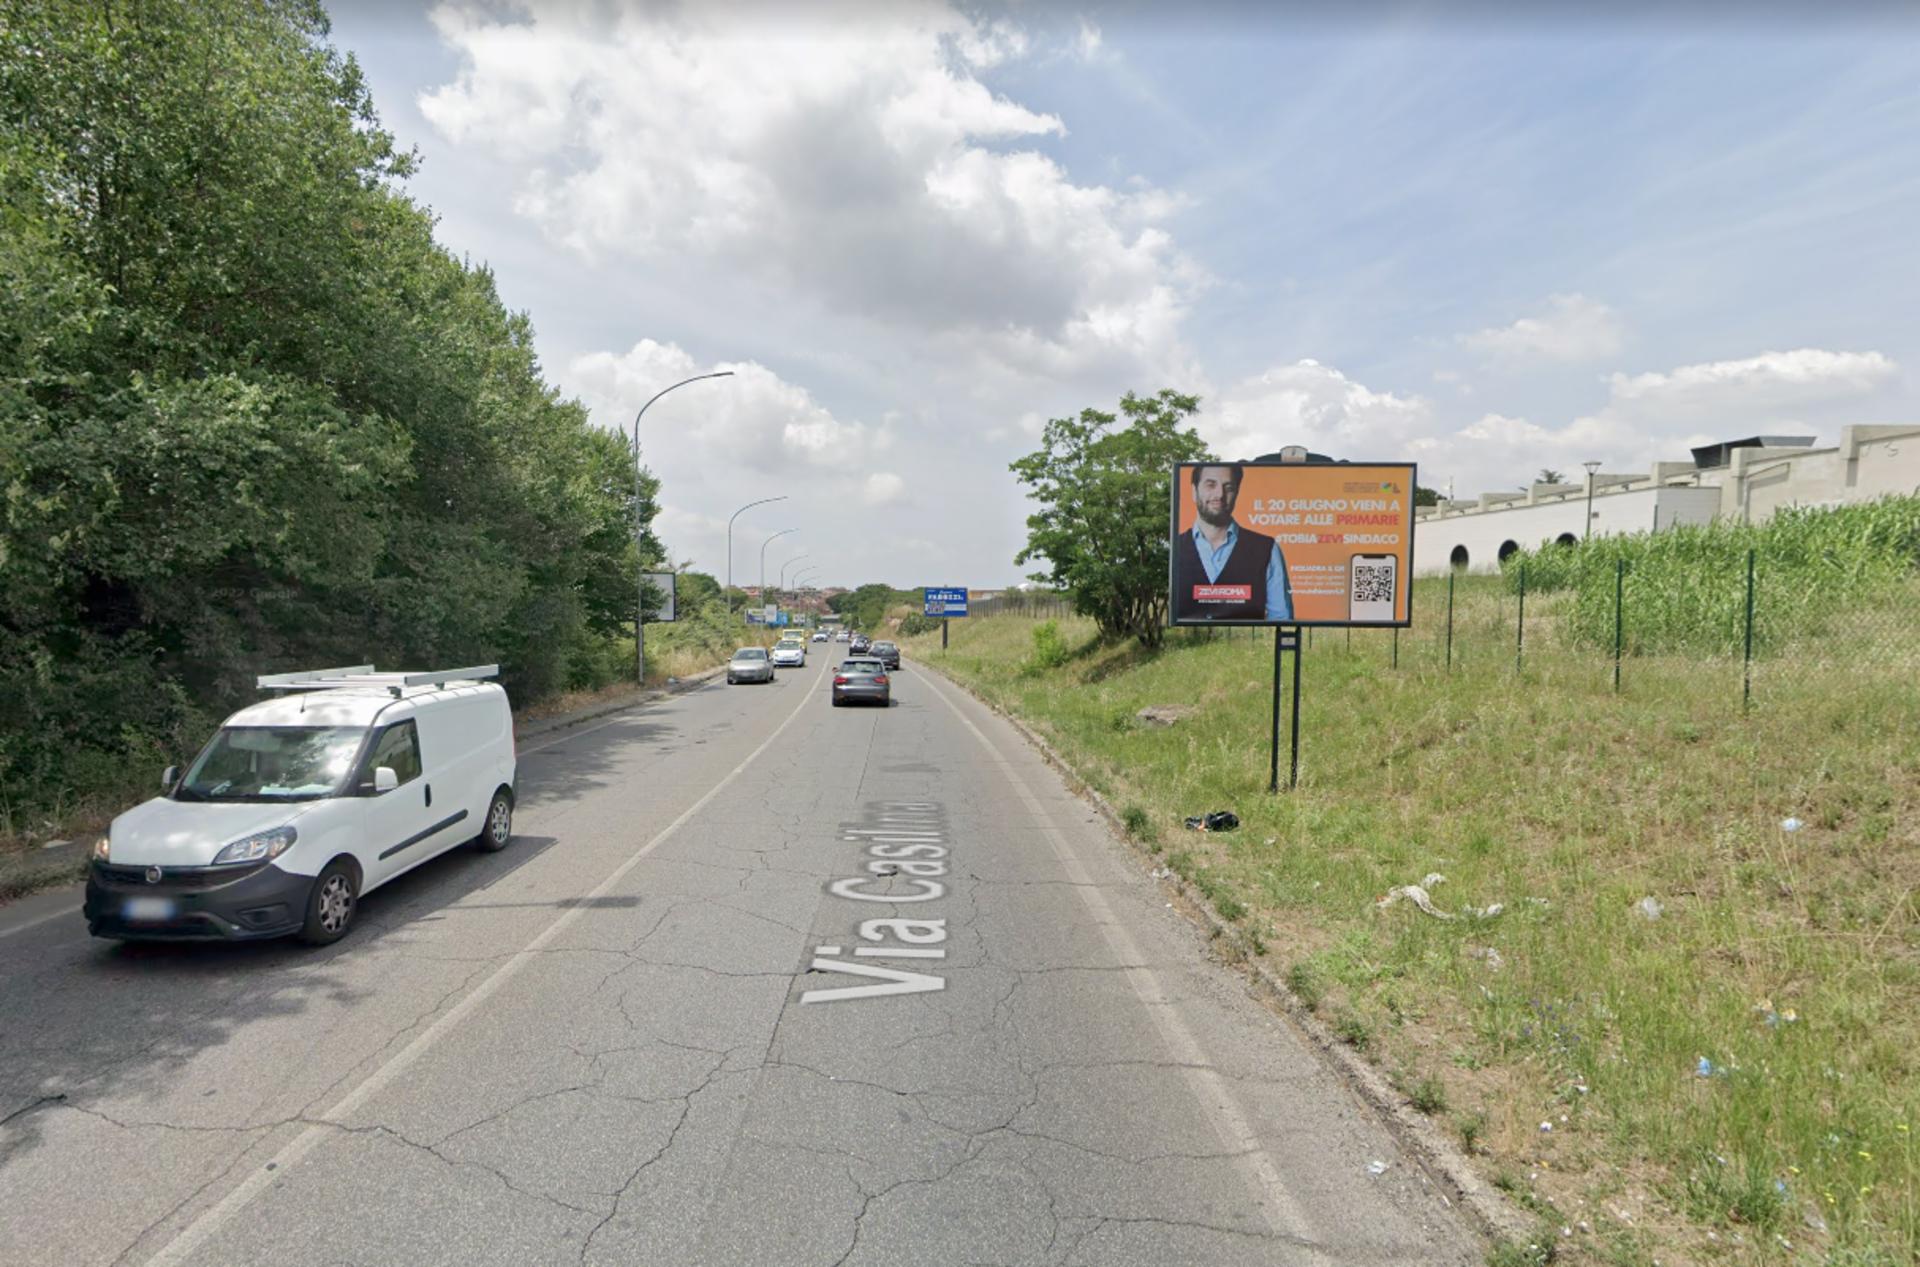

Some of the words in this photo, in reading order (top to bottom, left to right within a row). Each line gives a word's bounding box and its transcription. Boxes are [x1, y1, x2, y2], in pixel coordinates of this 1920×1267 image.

[1253, 499, 1265, 511] IL
[1268, 499, 1286, 511] 20
[1288, 499, 1347, 511] GIUGNO
[1351, 499, 1386, 511] VIENI
[1389, 499, 1400, 511] A
[1248, 513, 1300, 525] VOTARE
[1304, 513, 1333, 525] ALLE
[1337, 513, 1399, 525] PRIMARIE
